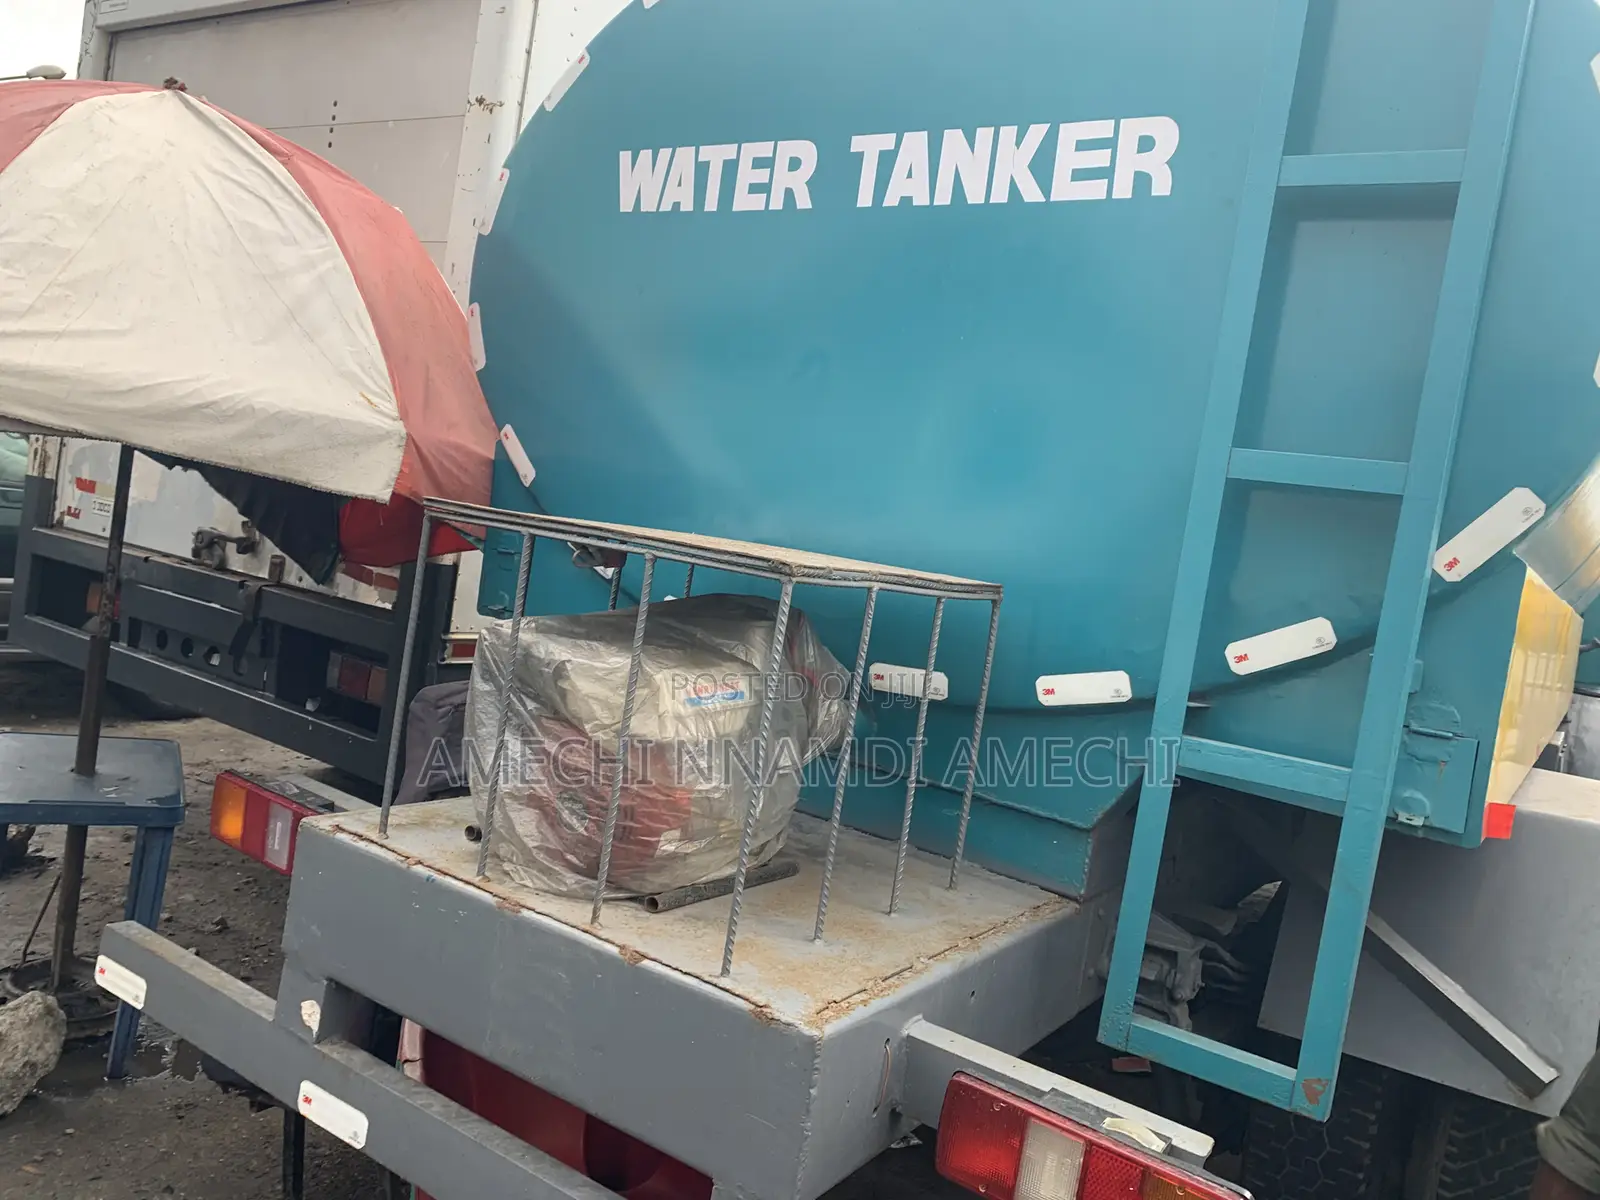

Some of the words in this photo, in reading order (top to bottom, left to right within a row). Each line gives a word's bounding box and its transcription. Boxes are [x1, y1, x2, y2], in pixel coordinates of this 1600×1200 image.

[618, 139, 818, 213] WATER
[849, 115, 1180, 207] TANKER
[1443, 557, 1461, 572] 3M
[1233, 653, 1250, 664] 3M
[873, 673, 885, 681] 3M
[1042, 688, 1056, 696] 3M
